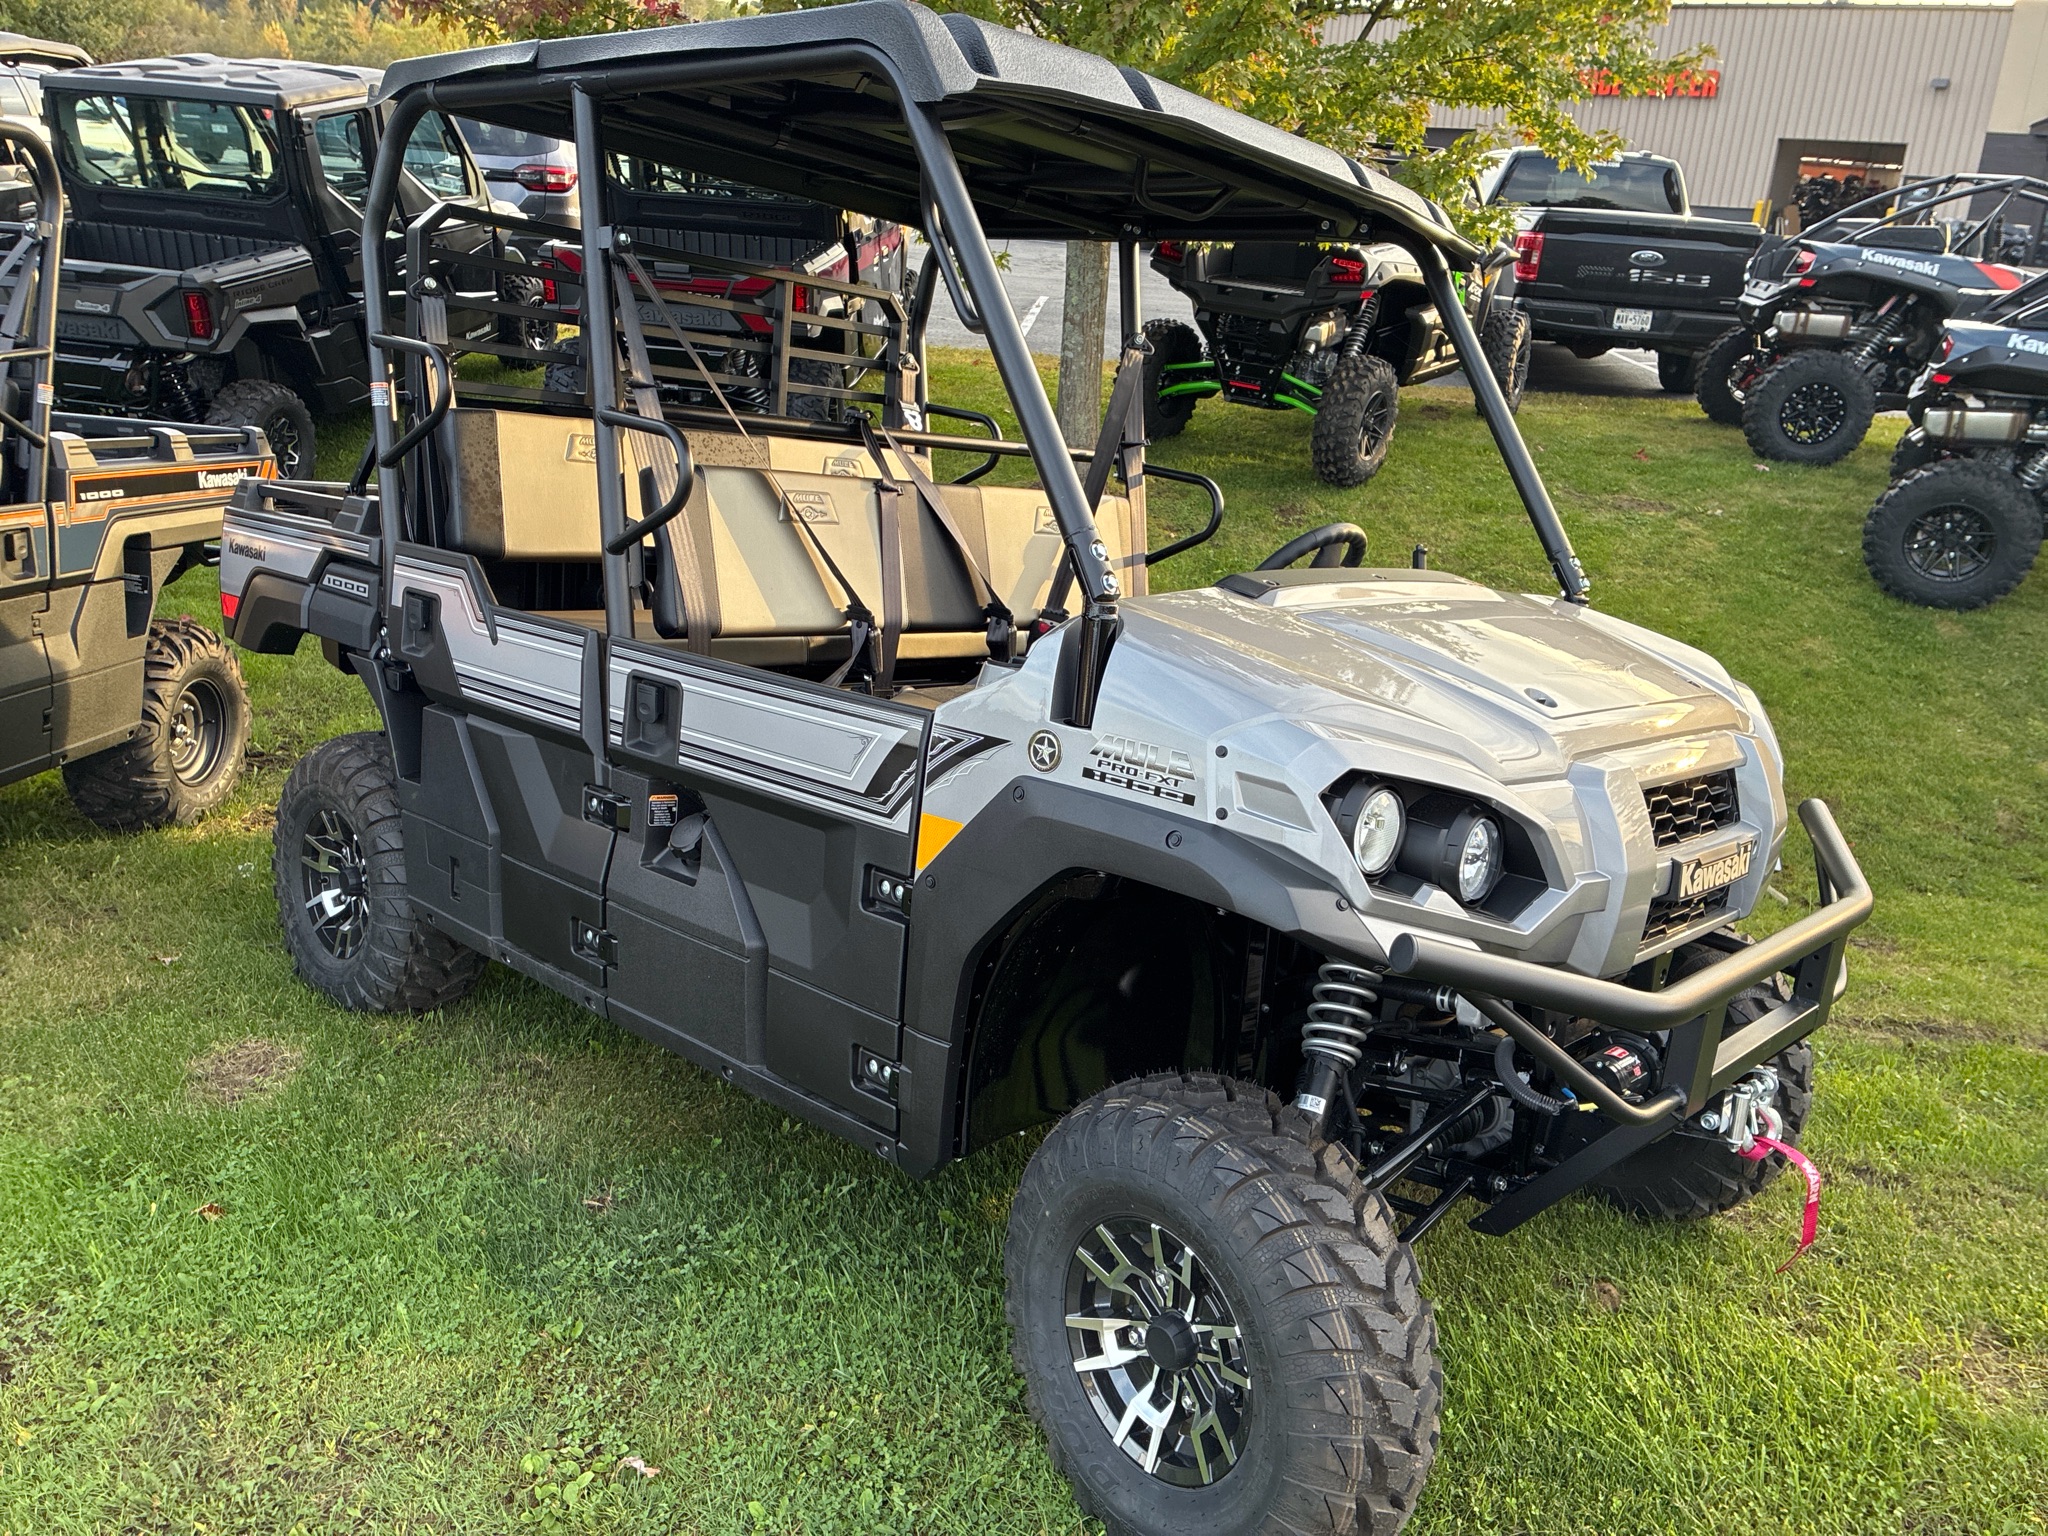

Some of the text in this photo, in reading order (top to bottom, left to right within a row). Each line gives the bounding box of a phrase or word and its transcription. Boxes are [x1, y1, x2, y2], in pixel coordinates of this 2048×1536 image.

[1861, 248, 1940, 277] Kawasaki
[57, 321, 121, 340] wasaki
[79, 488, 124, 500] 1000
[229, 538, 267, 562] Kawasaki
[326, 576, 367, 594] 1000
[1089, 732, 1196, 781] MULE
[1092, 770, 1185, 803] 1000
[1097, 759, 1185, 788] PRO-FXT
[1680, 843, 1752, 898] Kawasaki
[1802, 1160, 1820, 1204] WARN
